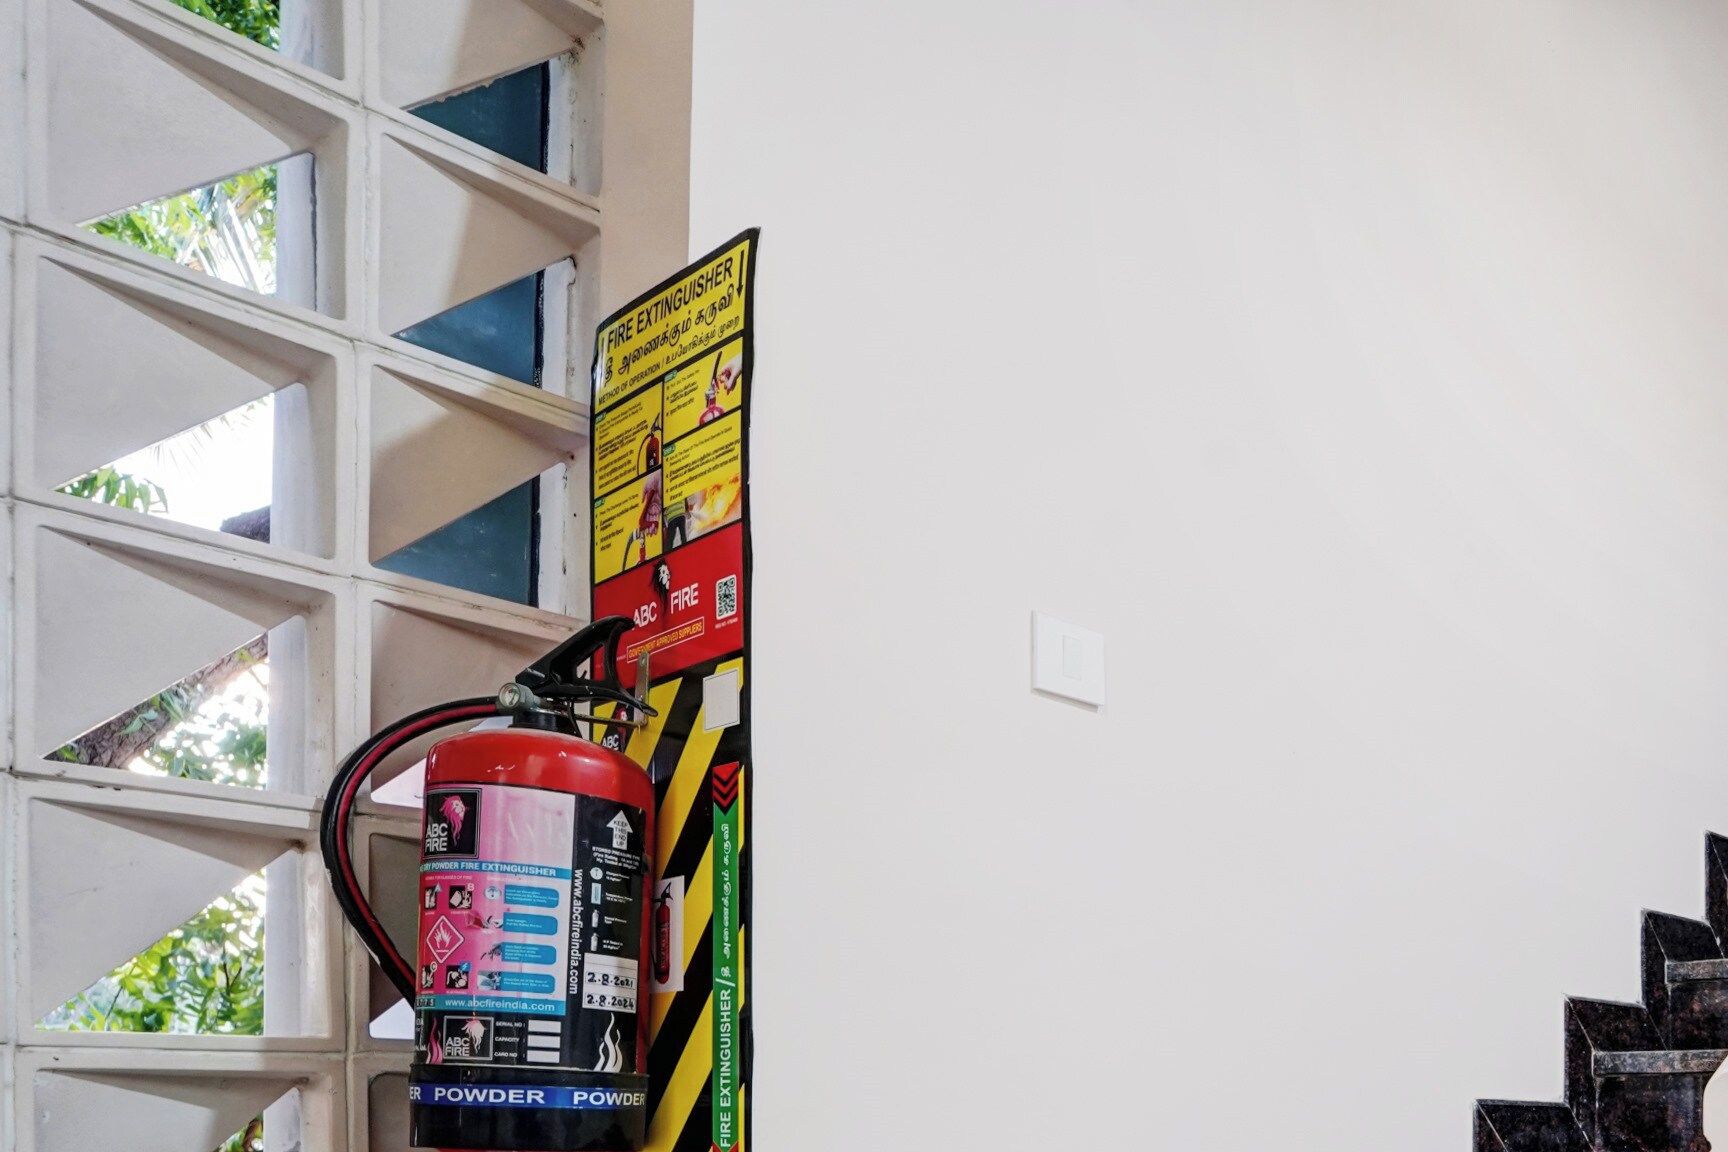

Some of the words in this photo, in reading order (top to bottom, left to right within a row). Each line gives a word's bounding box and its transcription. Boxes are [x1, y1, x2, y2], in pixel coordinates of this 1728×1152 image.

[607, 318, 634, 353] FIRE
[637, 257, 733, 334] EXTINGUISHER
[695, 283, 735, 326] கருவி
[599, 386, 620, 405] METHOD
[621, 380, 628, 391] OF
[629, 361, 660, 390] OPERATION
[632, 601, 657, 631] ABC
[671, 582, 699, 614] FIRE
[602, 735, 619, 749] ABC
[425, 823, 448, 838] ABC
[425, 837, 448, 852] FIRE
[431, 862, 459, 870] POWDER
[461, 862, 480, 870] FIRE
[482, 862, 557, 877] EXTINGUISHER
[466, 883, 475, 891] B
[569, 868, 584, 994] www.abcfireindia.com
[445, 999, 555, 1012] www.abcfireindia.com
[445, 1037, 470, 1047] ABC
[720, 989, 731, 1107] EXTINGUISHER
[445, 1047, 470, 1057] FIRE
[434, 1087, 545, 1104] POWDER
[573, 1091, 645, 1106] POWDER
[720, 1112, 731, 1148] FIRE
